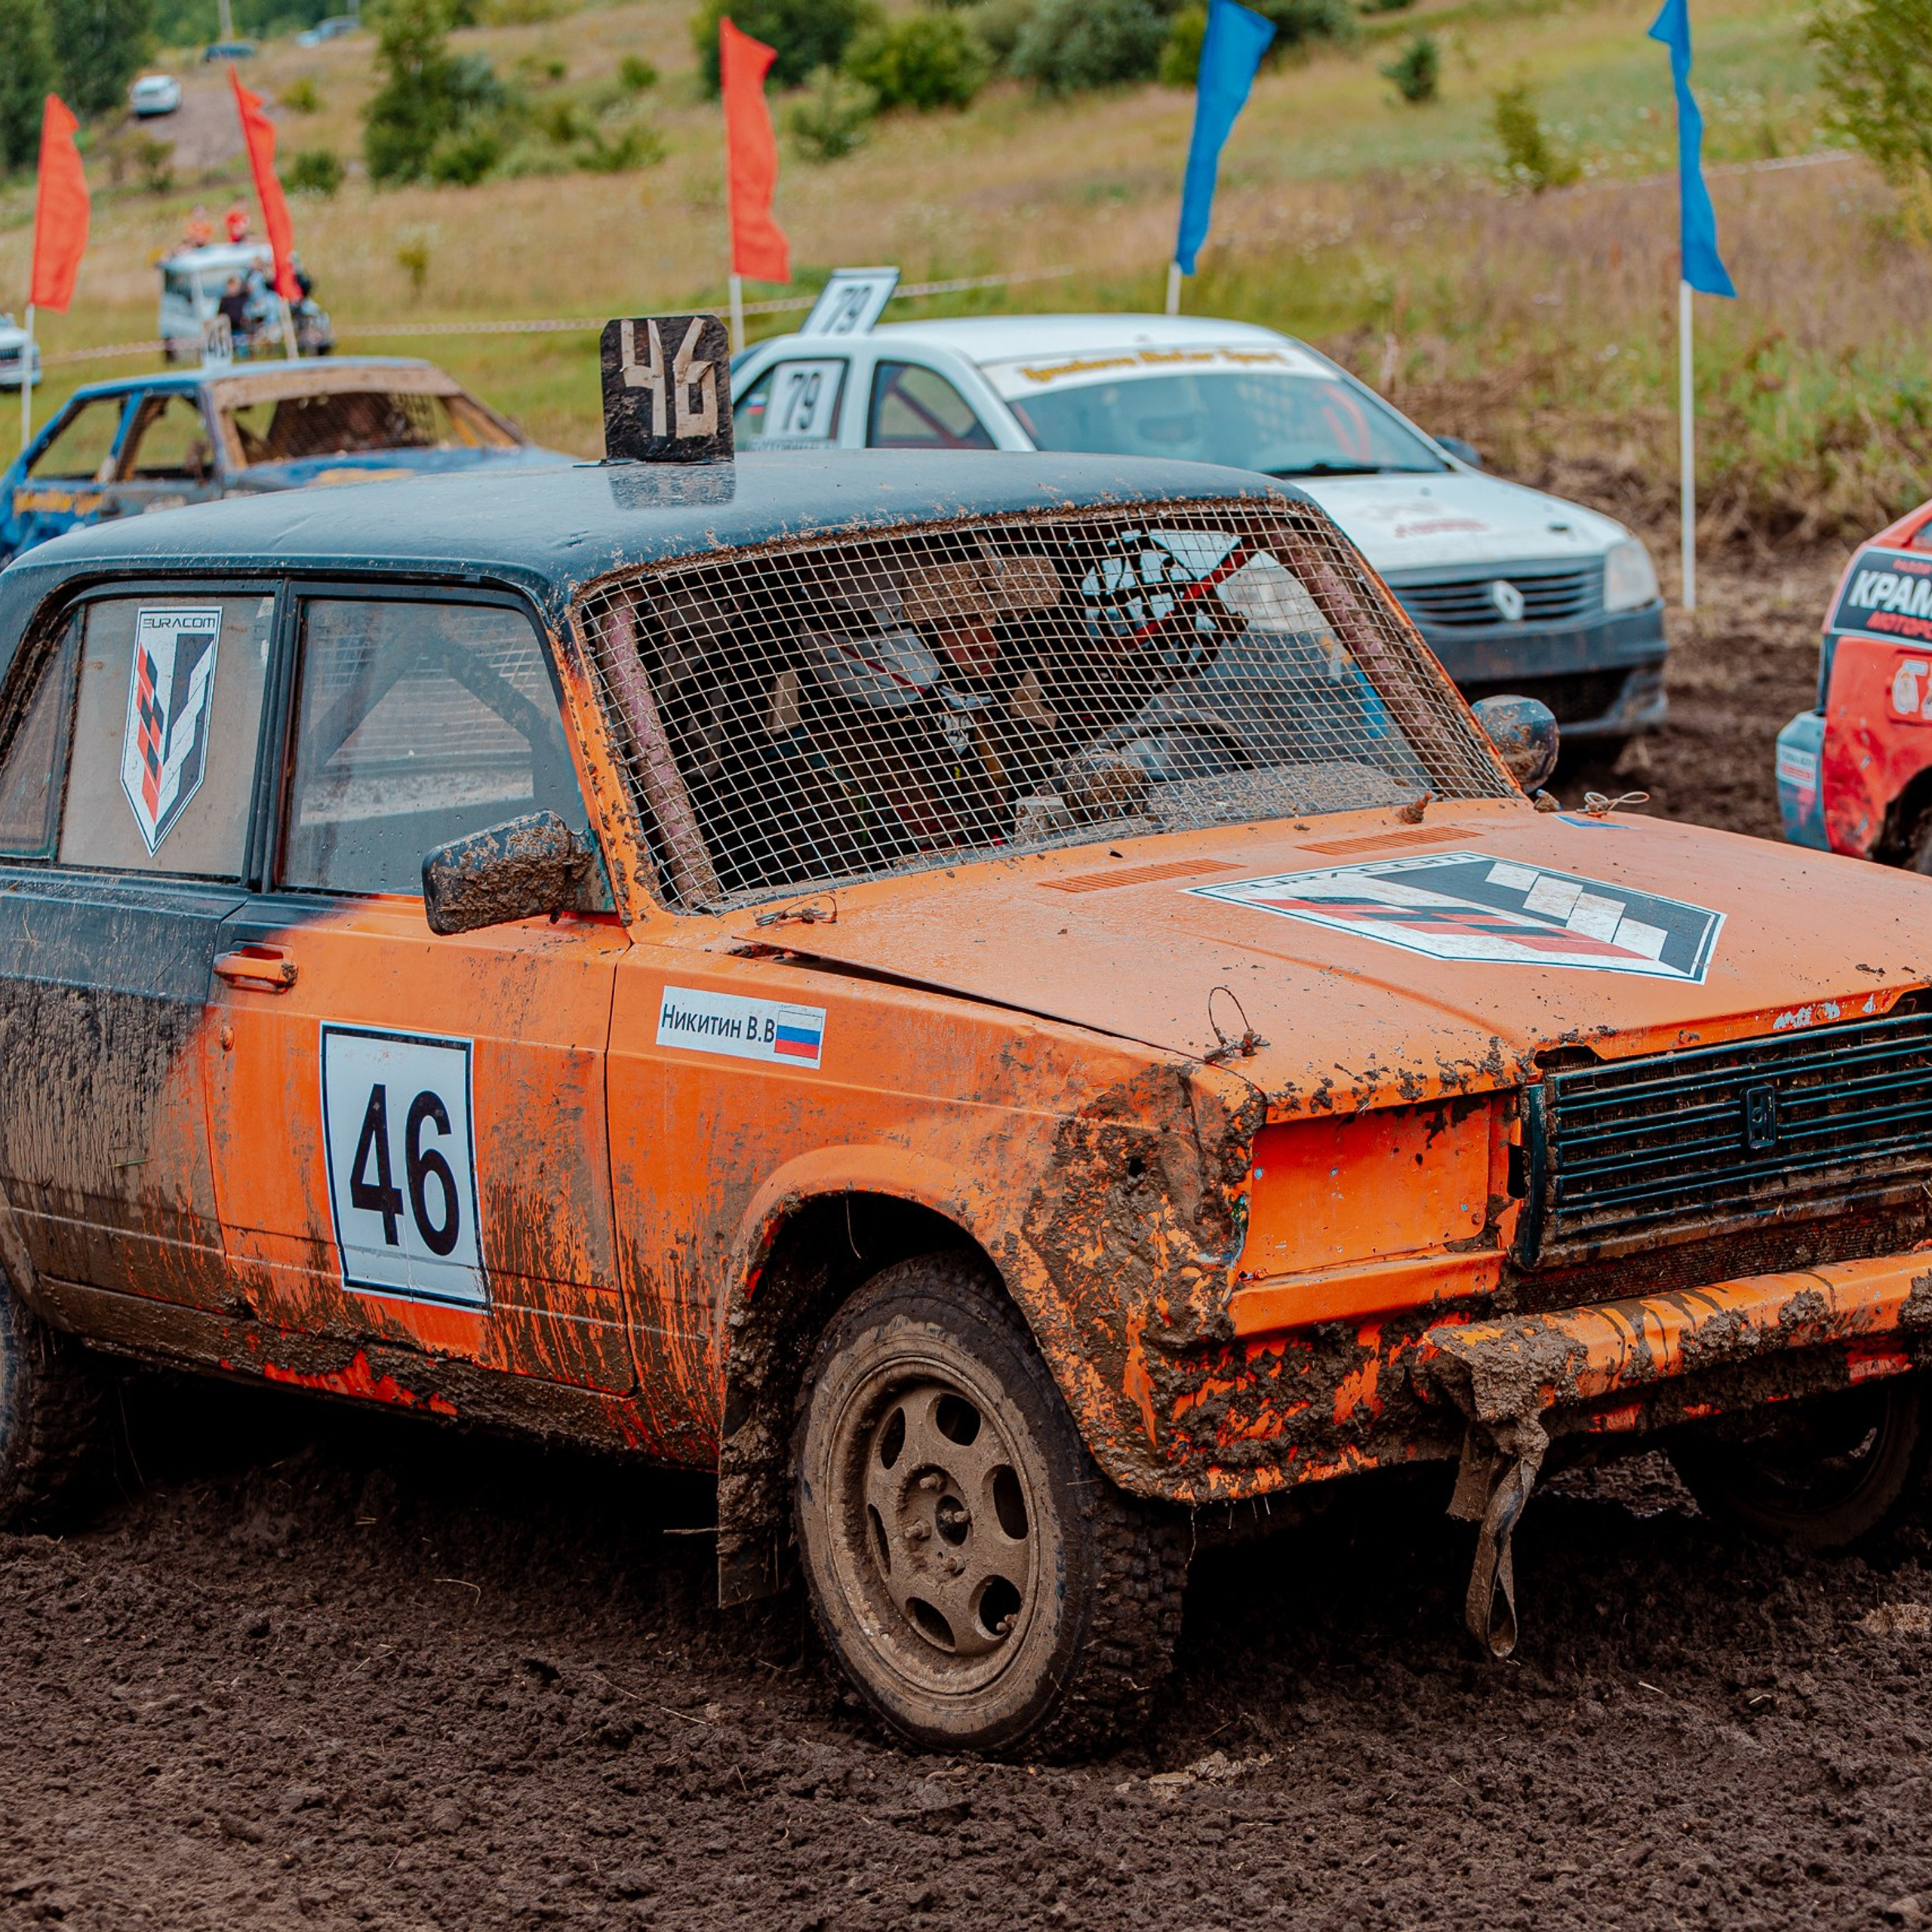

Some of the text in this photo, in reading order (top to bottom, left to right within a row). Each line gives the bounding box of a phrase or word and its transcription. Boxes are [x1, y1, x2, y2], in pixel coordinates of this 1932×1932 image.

[822, 287, 874, 334] 79
[620, 316, 718, 439] 46
[783, 370, 822, 430] 79
[143, 617, 216, 629] EURACOM
[661, 1004, 775, 1044] Никитин В.В
[350, 1083, 460, 1257] 46
